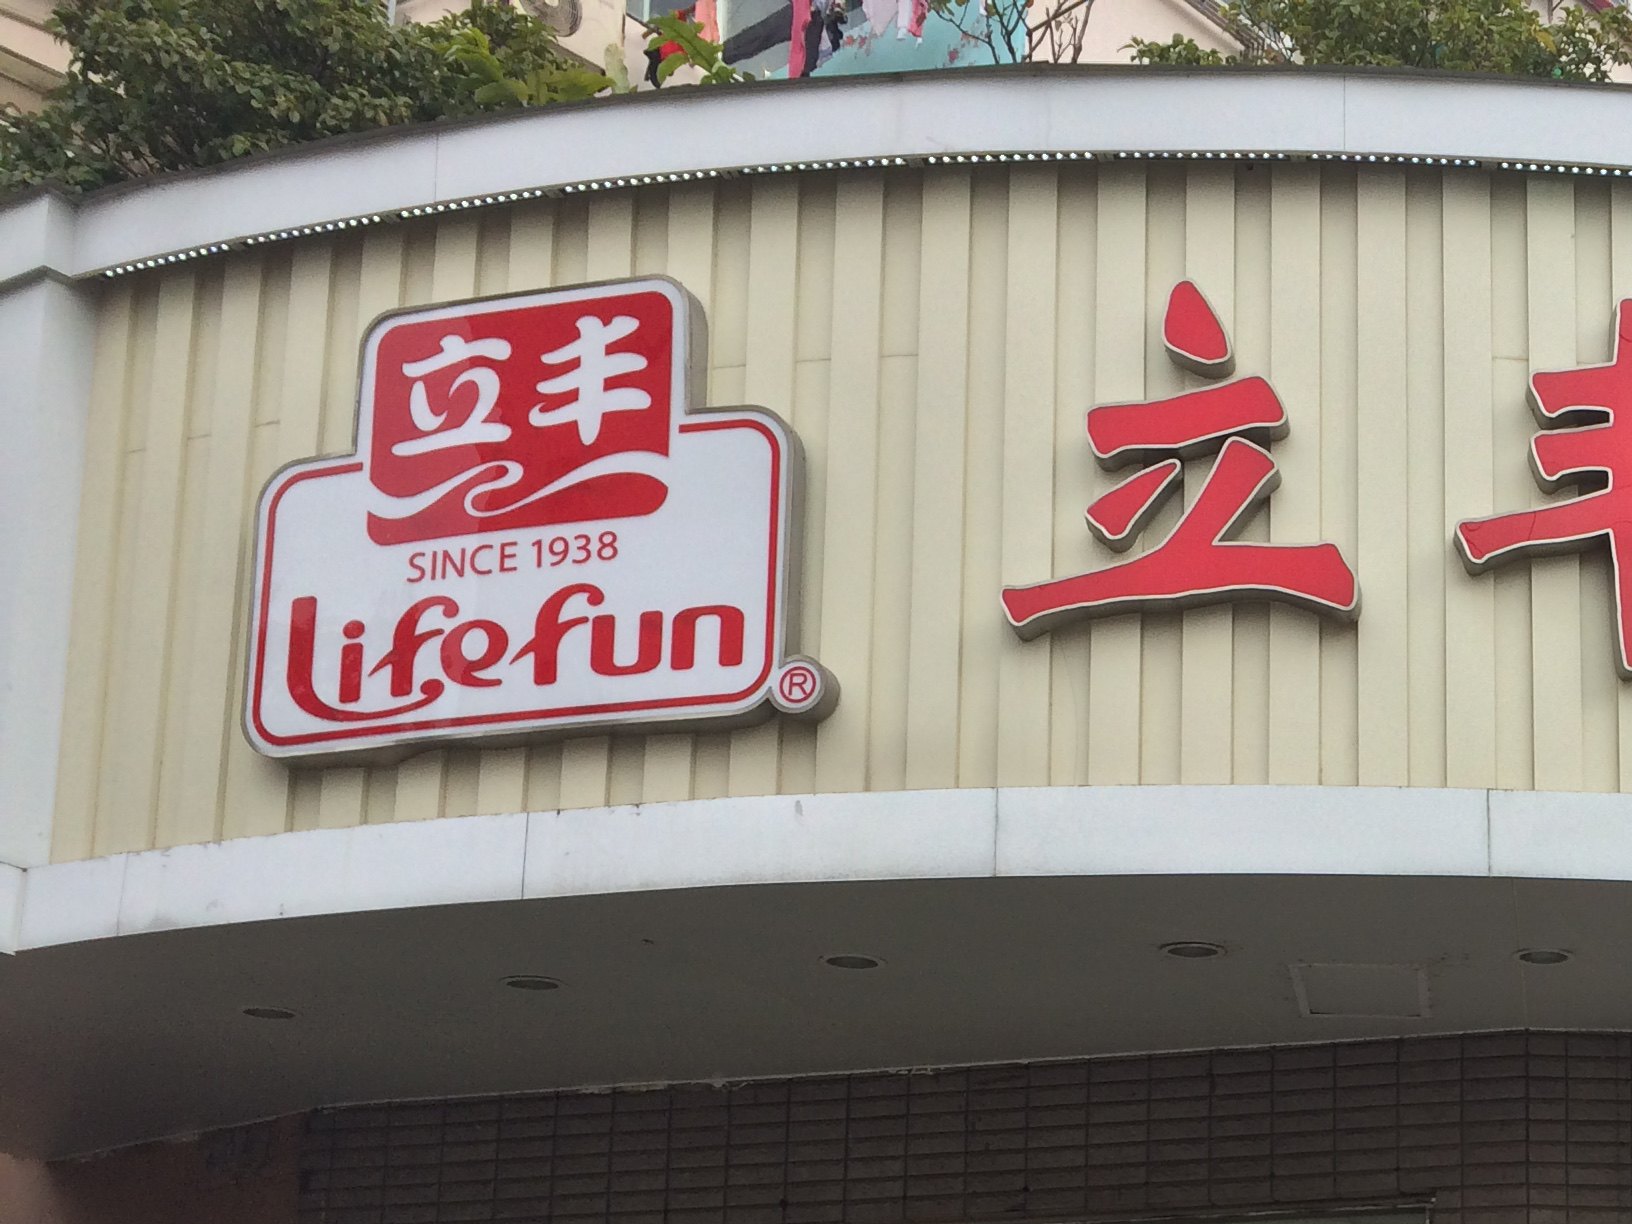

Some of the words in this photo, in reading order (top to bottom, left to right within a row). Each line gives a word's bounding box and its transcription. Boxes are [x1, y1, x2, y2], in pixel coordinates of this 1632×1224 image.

[391, 314, 652, 456] 立丰
[406, 543, 518, 583] SINCE
[532, 531, 619, 568] 1938
